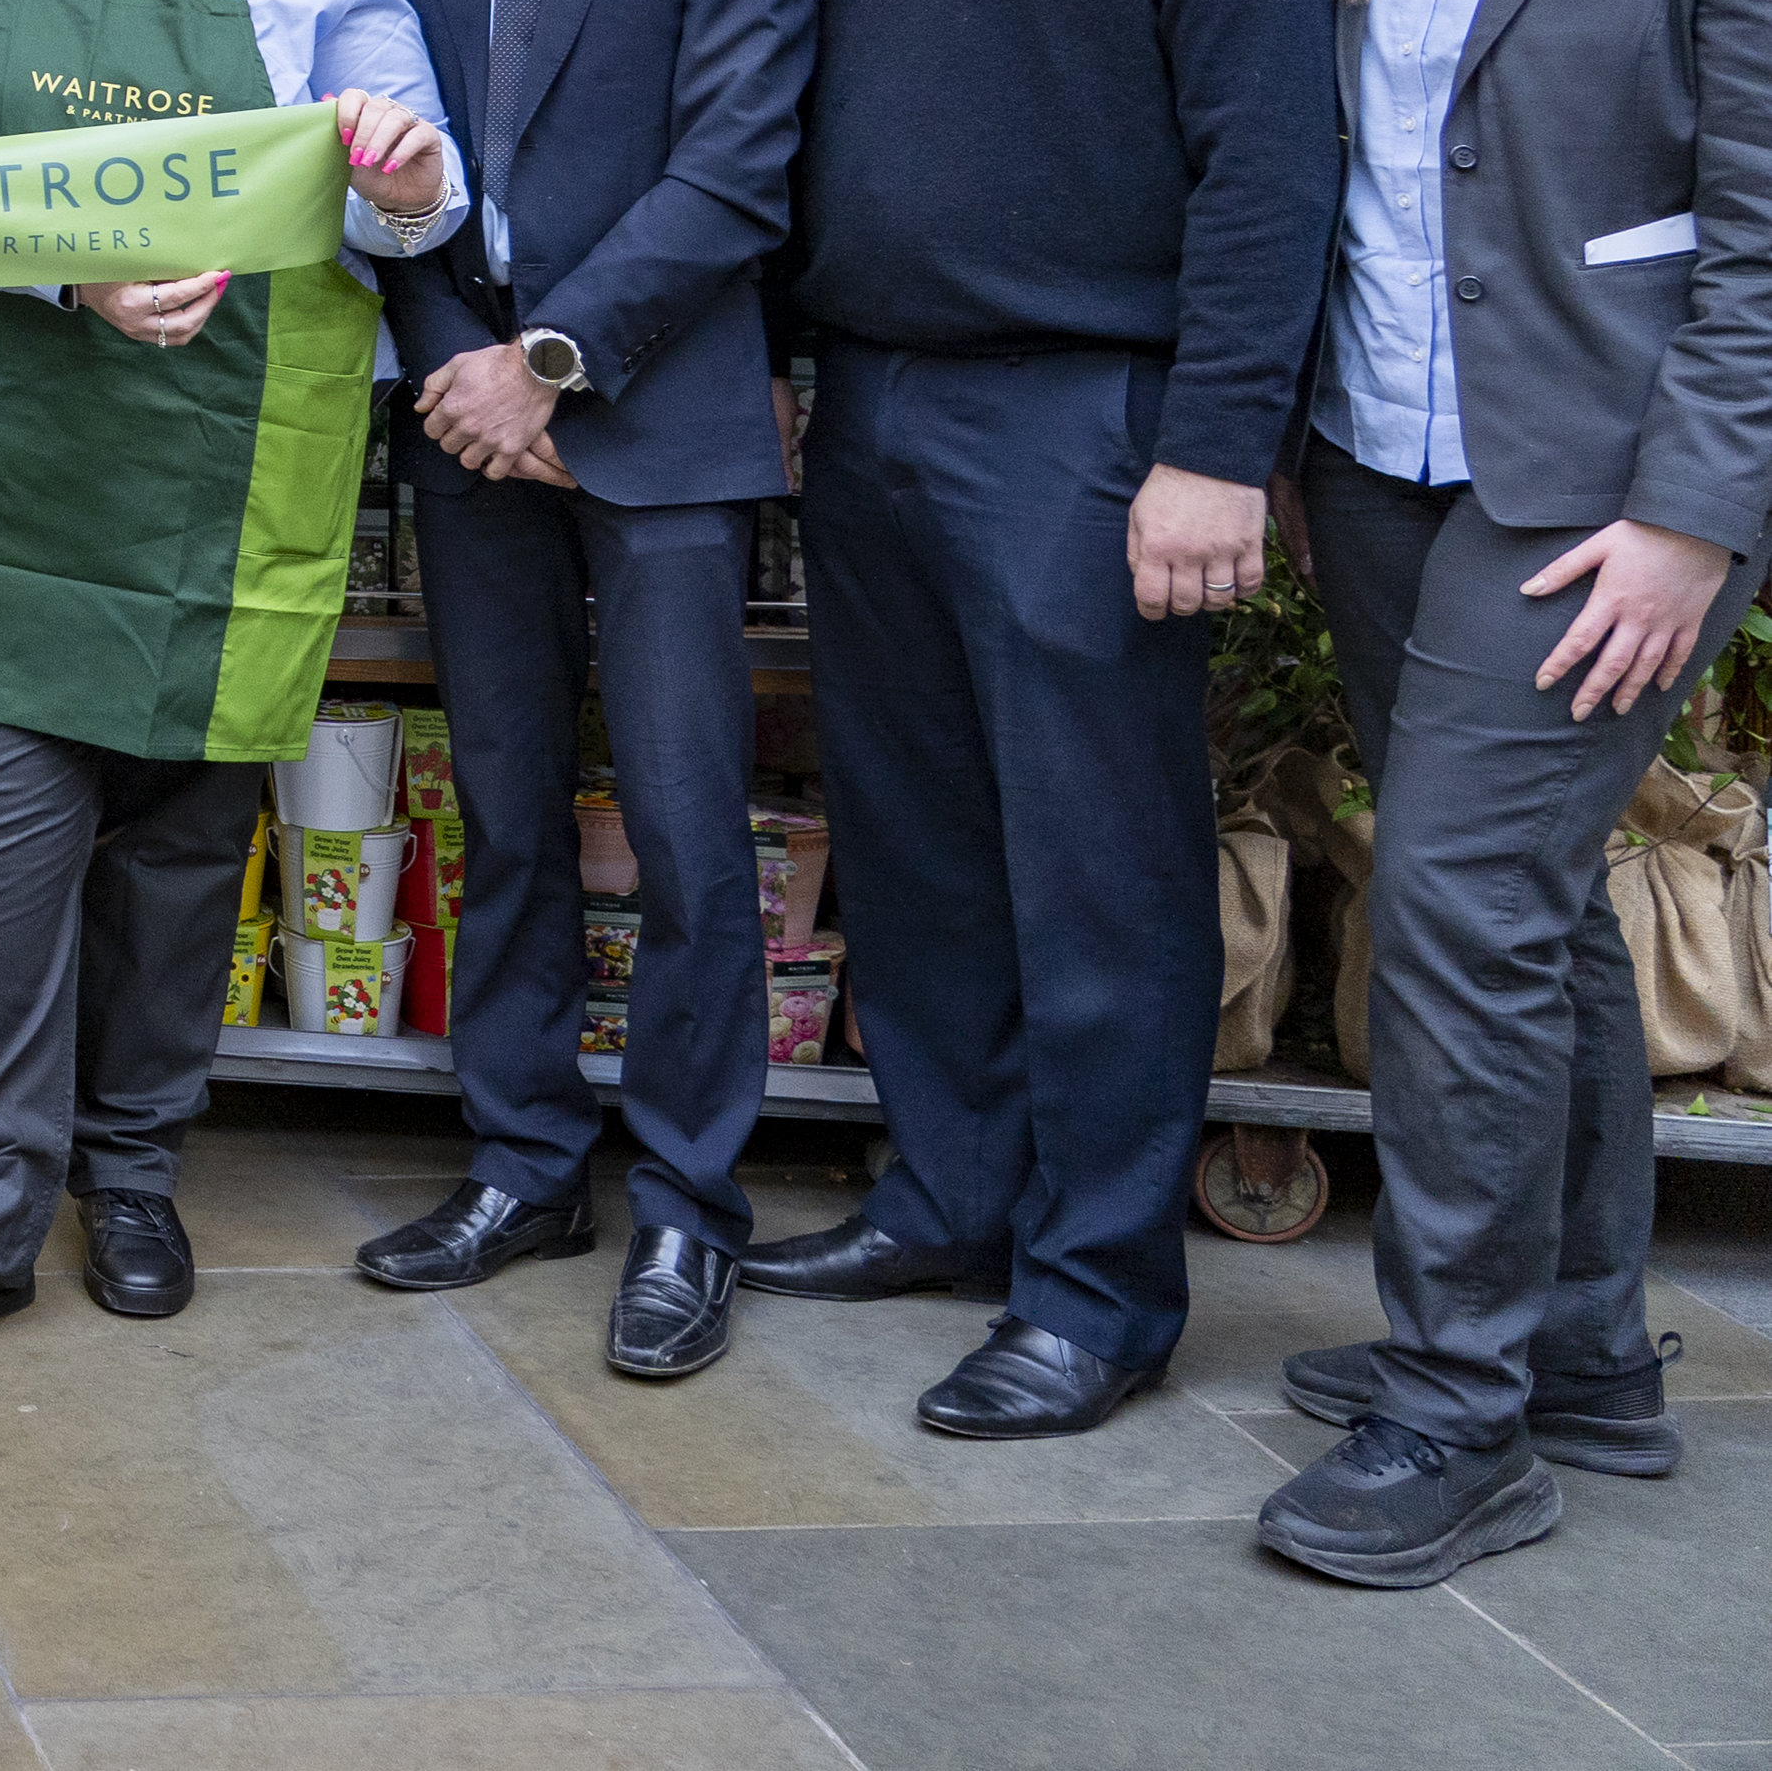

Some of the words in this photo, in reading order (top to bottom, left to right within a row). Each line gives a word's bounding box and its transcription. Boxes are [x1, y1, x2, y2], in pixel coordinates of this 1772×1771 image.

[31, 70, 214, 116] WAITROSE
[65, 104, 76, 115] &
[313, 835, 333, 843] Grow
[314, 843, 330, 852] Own
[310, 851, 353, 862] Strawberries
[336, 955, 352, 963] Own
[353, 956, 372, 964] Juicy
[332, 963, 376, 971] Strawberries
